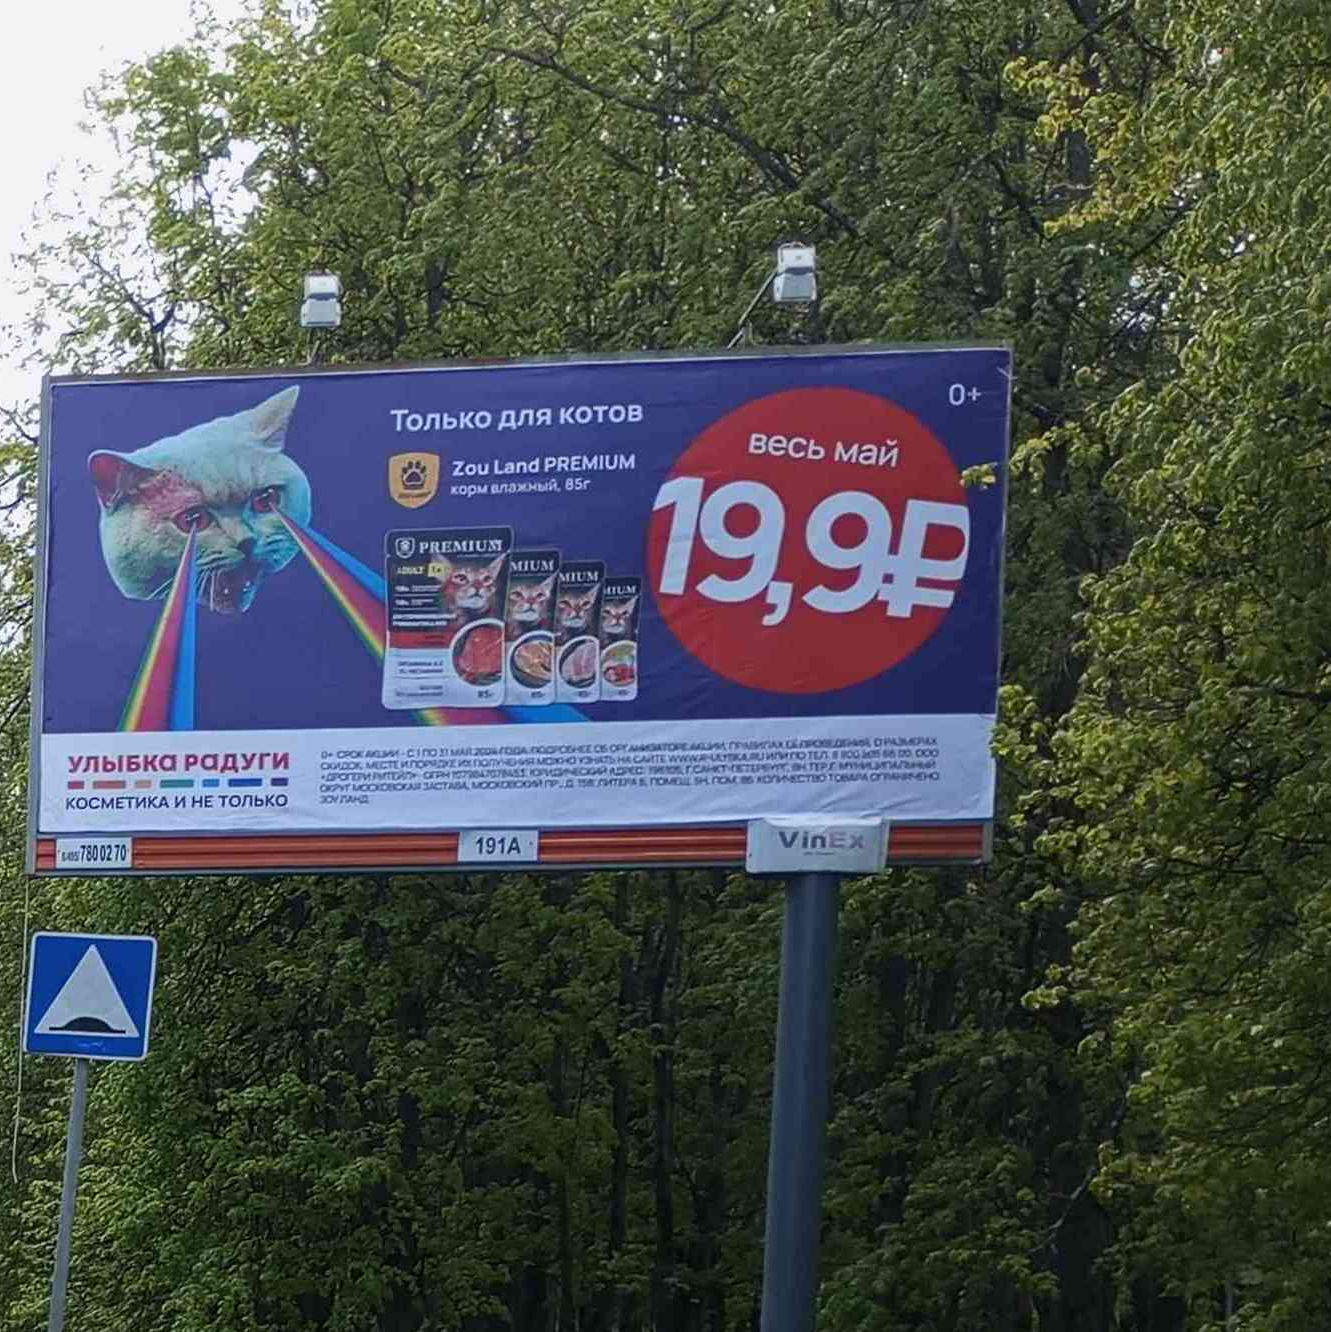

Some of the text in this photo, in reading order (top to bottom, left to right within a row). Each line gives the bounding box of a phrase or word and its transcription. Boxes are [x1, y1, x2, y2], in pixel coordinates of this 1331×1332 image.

[948, 383, 982, 405] 0+
[390, 404, 644, 432] Только для котов
[748, 432, 899, 468] весь май
[451, 454, 636, 477] Zou Land PREMIUM
[450, 478, 592, 498] корм влажный, 85г
[419, 538, 503, 553] PREMIUM
[511, 559, 555, 572] MIUM
[65, 794, 288, 810] КОСМЕТИКА И НЕ ТОЛЬКО
[474, 835, 522, 855] 191A
[778, 831, 865, 849] VinEx
